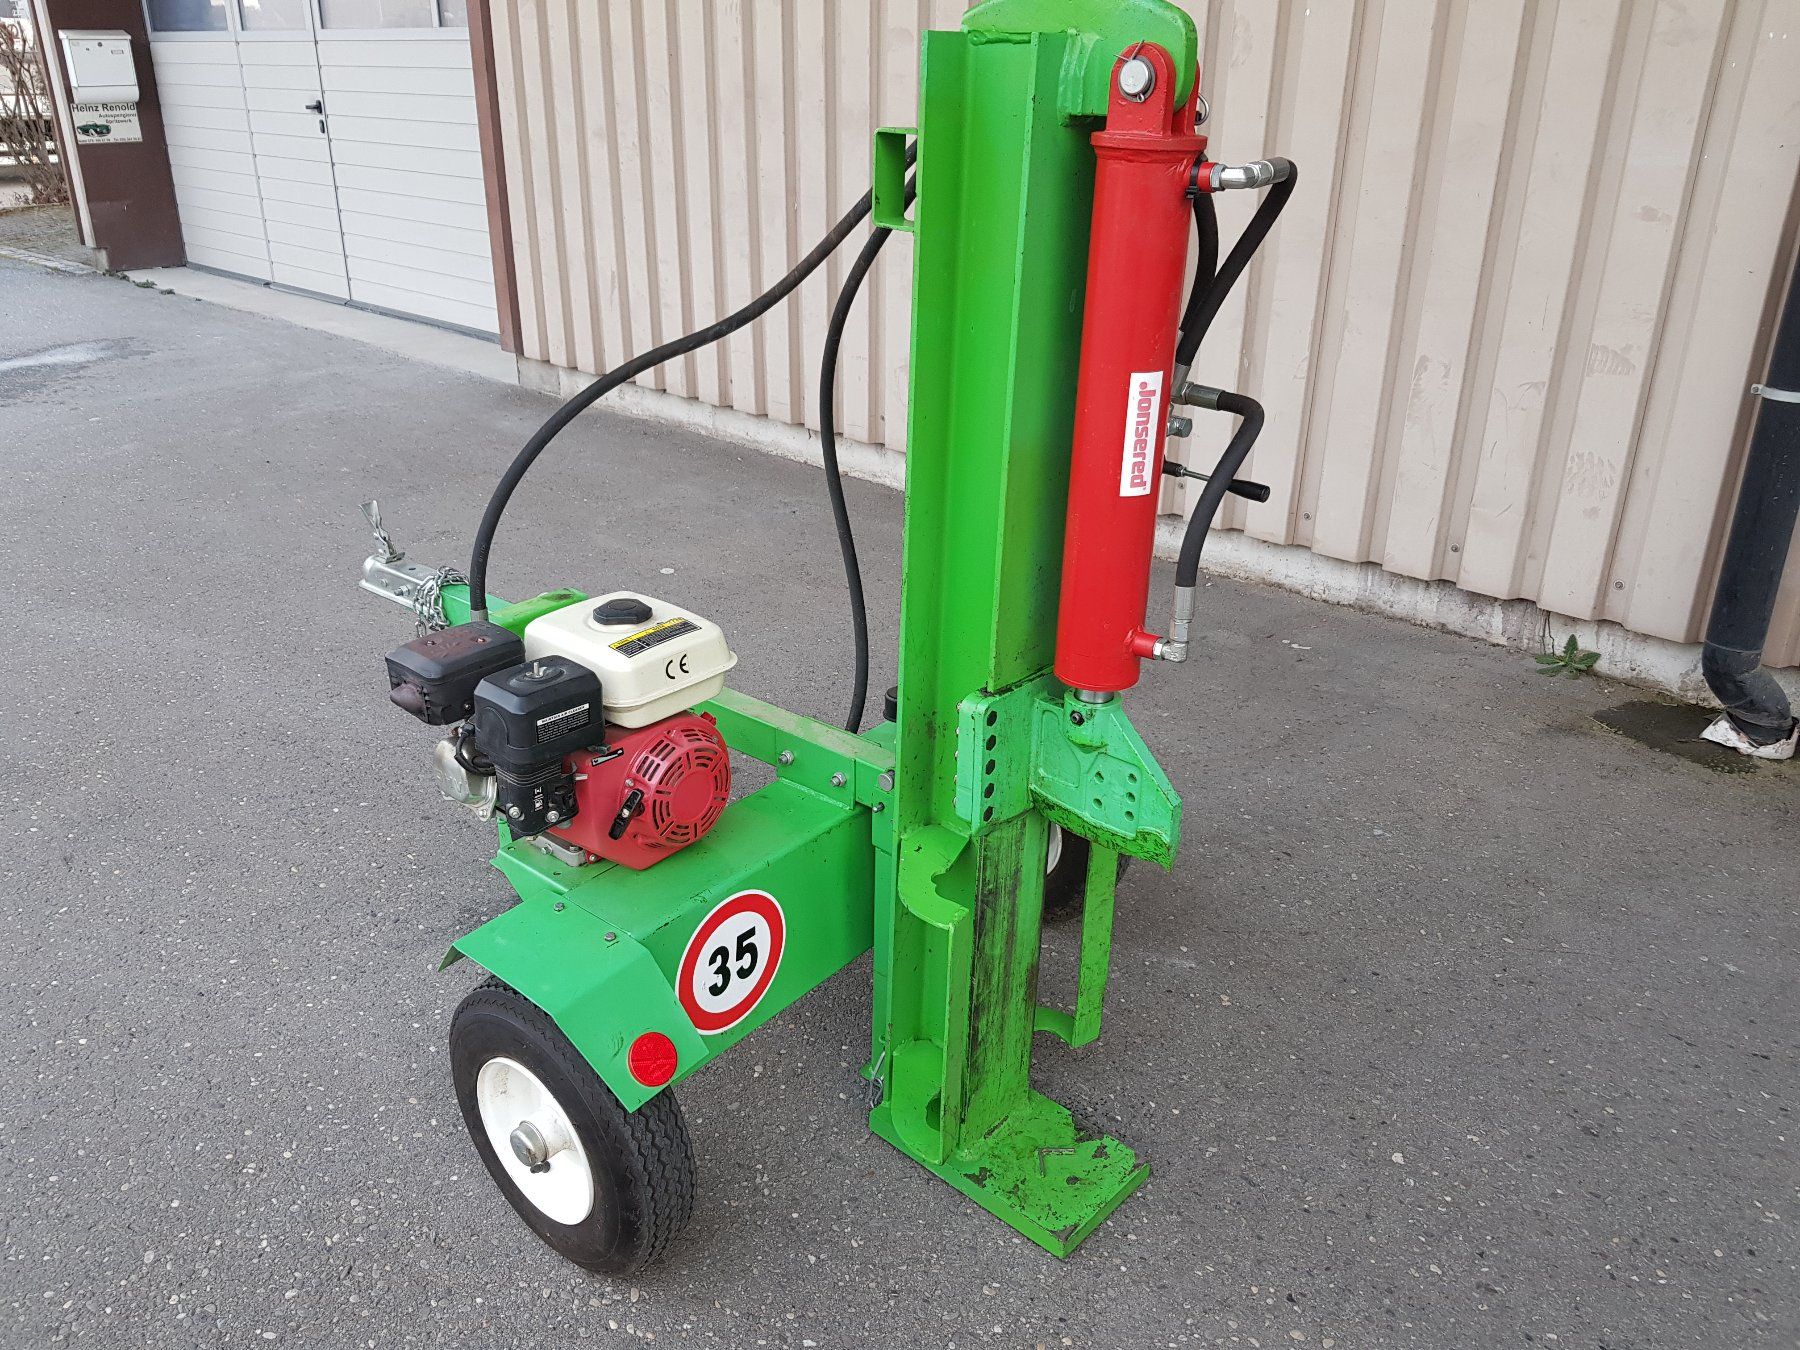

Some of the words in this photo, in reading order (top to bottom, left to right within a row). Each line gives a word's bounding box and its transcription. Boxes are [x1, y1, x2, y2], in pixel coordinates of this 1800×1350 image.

[72, 104, 99, 112] Heinz
[102, 103, 135, 111] Renold
[1130, 381, 1156, 488] Jonsered
[666, 654, 689, 679] CE
[708, 926, 758, 996] 35
